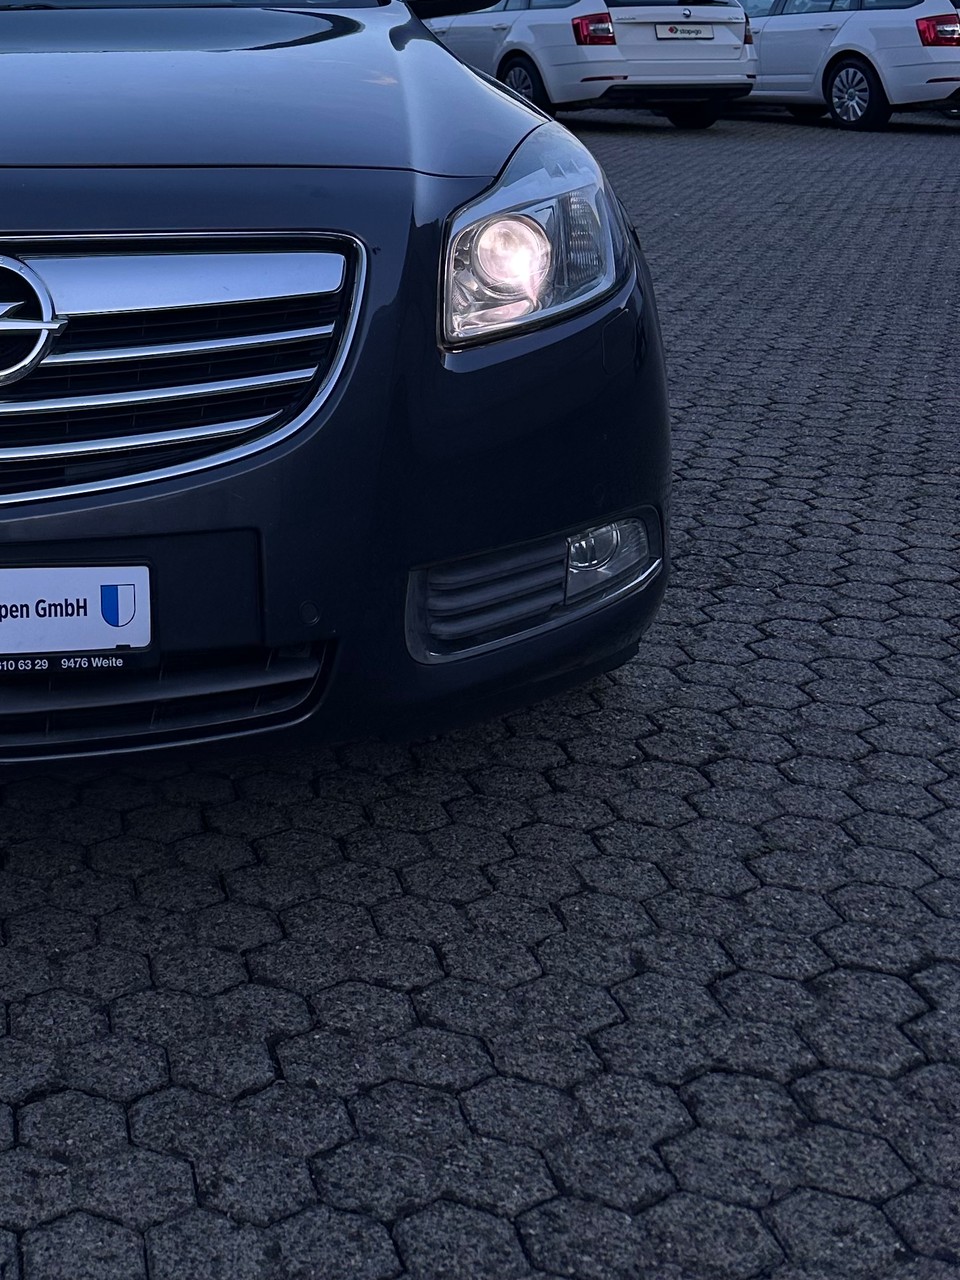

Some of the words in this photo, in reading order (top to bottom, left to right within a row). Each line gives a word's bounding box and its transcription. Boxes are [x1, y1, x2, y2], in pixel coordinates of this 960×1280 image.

[35, 598, 88, 618] GmbH
[17, 659, 32, 670] 63
[34, 659, 49, 670] 29
[61, 657, 89, 669] 9476
[91, 656, 124, 667] Weite
